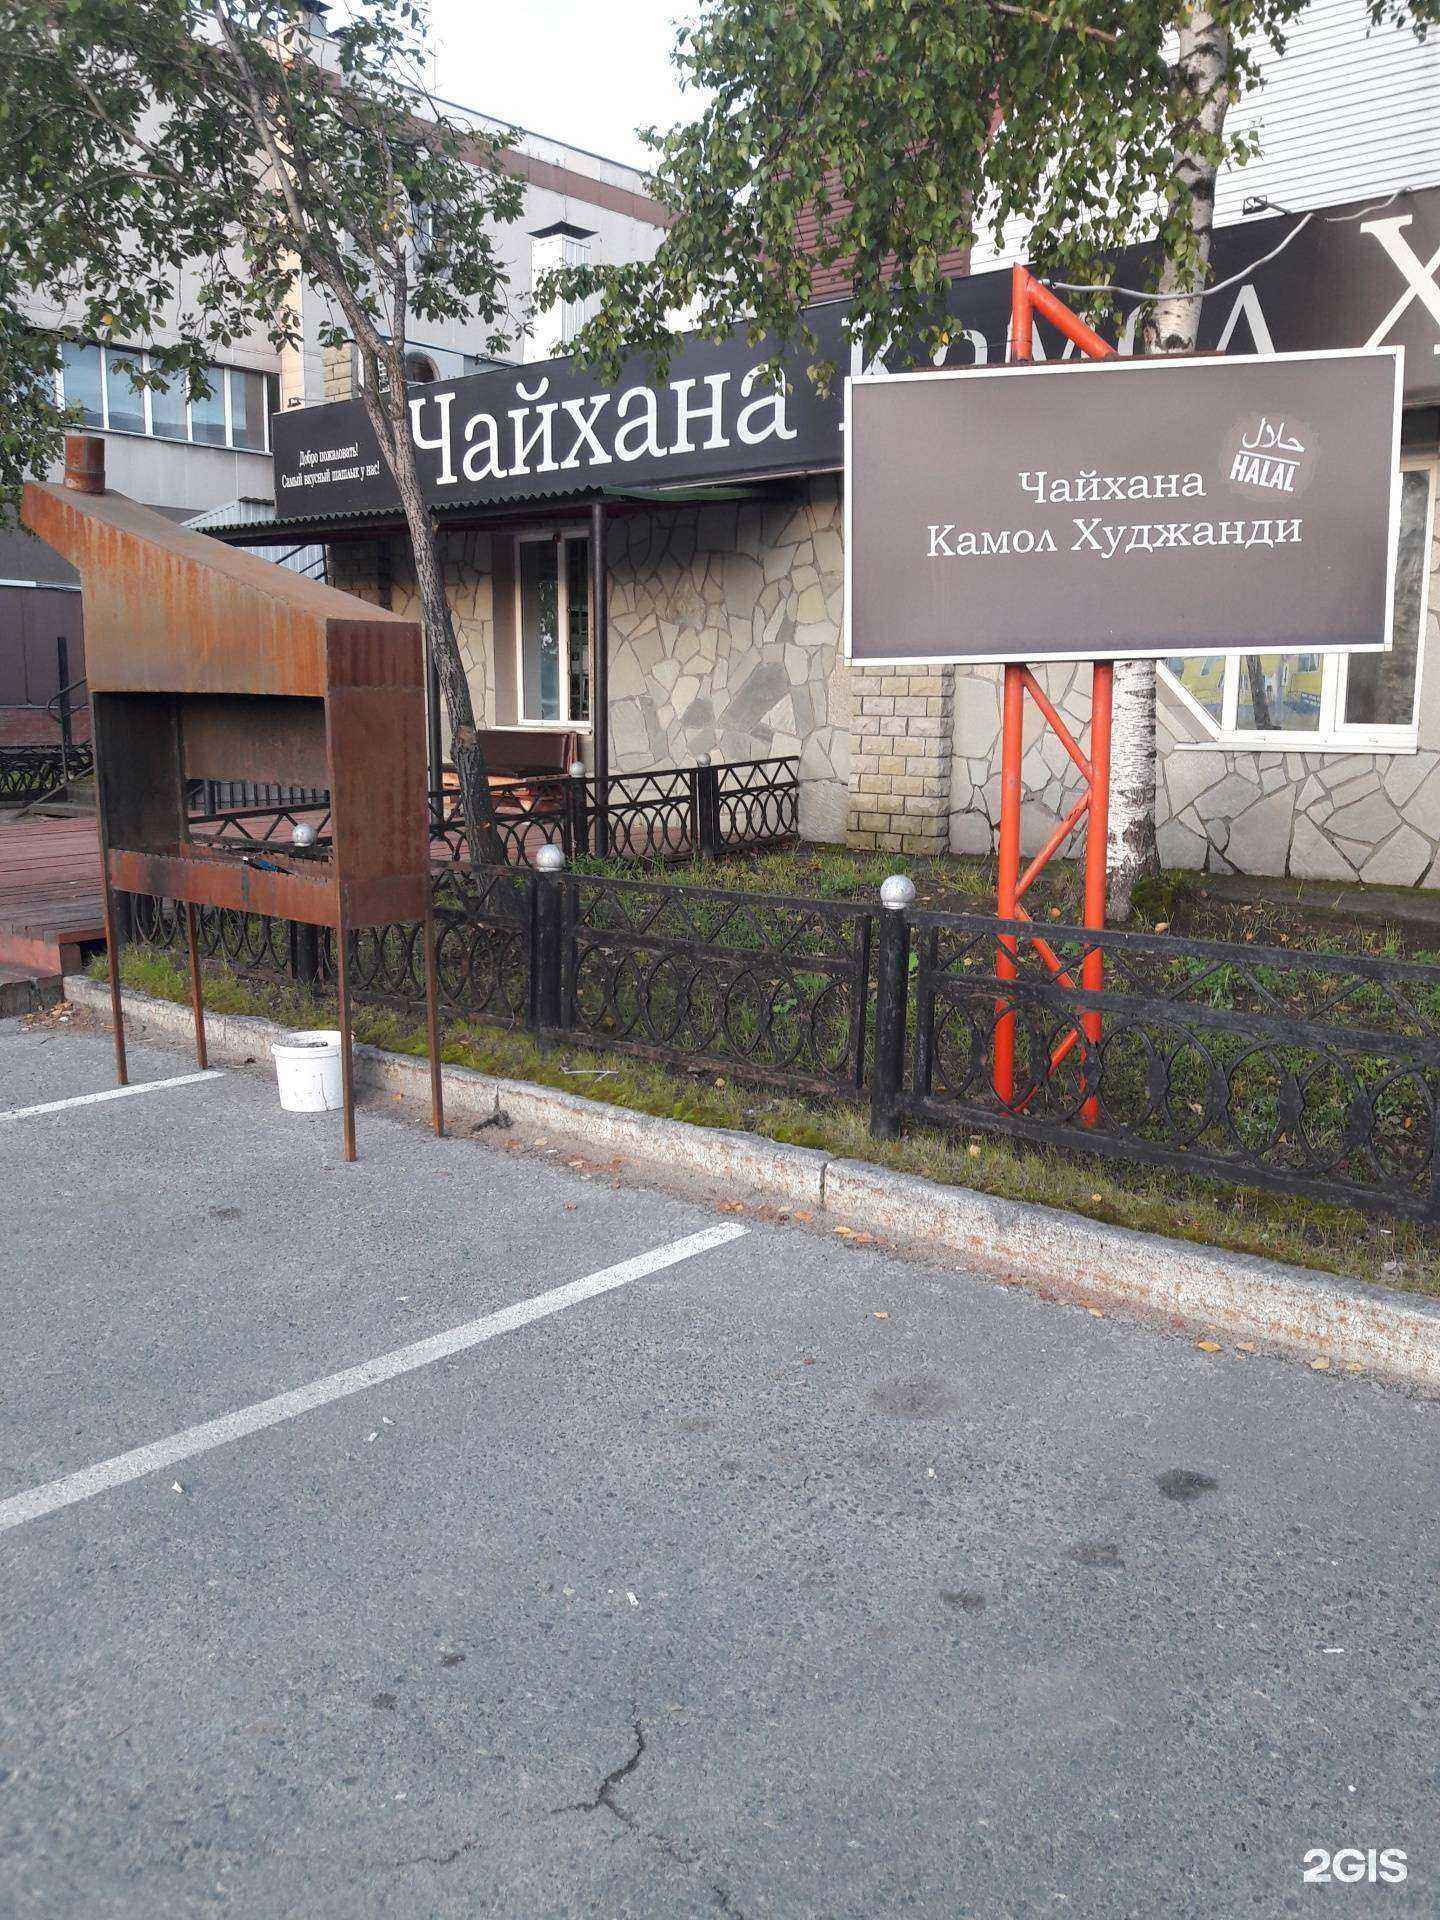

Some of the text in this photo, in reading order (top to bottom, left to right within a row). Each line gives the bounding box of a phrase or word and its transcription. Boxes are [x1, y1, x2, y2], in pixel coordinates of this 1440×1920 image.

[409, 363, 798, 485] Чайхана
[1242, 417, 1305, 452] حلال
[299, 441, 359, 467] Добро пожаловать!
[282, 473, 303, 488] Самый
[304, 469, 331, 487] вкусный
[332, 466, 359, 481] шашлык
[366, 460, 380, 476] нас!
[1018, 470, 1207, 504] Чайхана
[1230, 454, 1296, 491] HALAL
[926, 517, 1303, 559] Камол Худжанди
